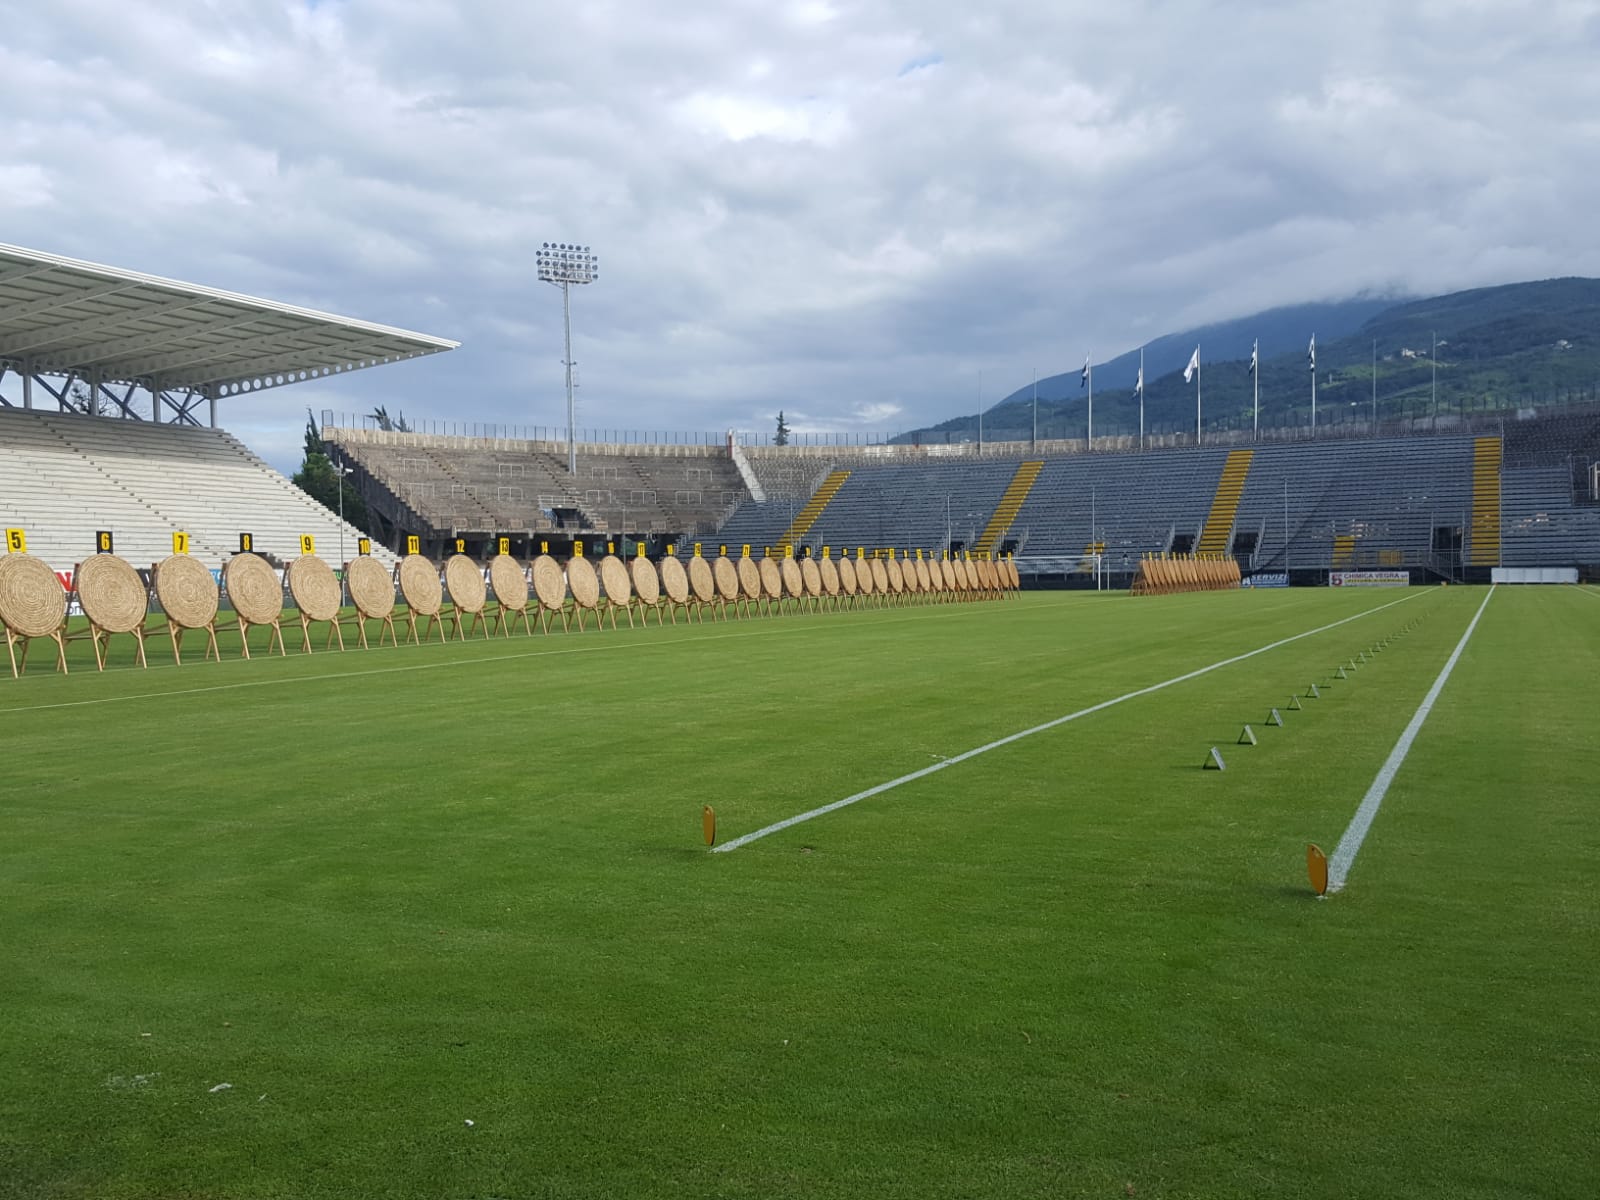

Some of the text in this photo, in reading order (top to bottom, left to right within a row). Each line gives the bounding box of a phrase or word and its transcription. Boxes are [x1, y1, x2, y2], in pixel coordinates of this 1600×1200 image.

[11, 531, 21, 549] 5
[101, 533, 110, 550] 6
[178, 535, 184, 551] 7
[243, 534, 250, 551] 8
[304, 536, 312, 551] 9
[360, 539, 370, 554] 10
[410, 538, 418, 551] 11
[456, 539, 465, 553] 12
[501, 540, 509, 552] 13
